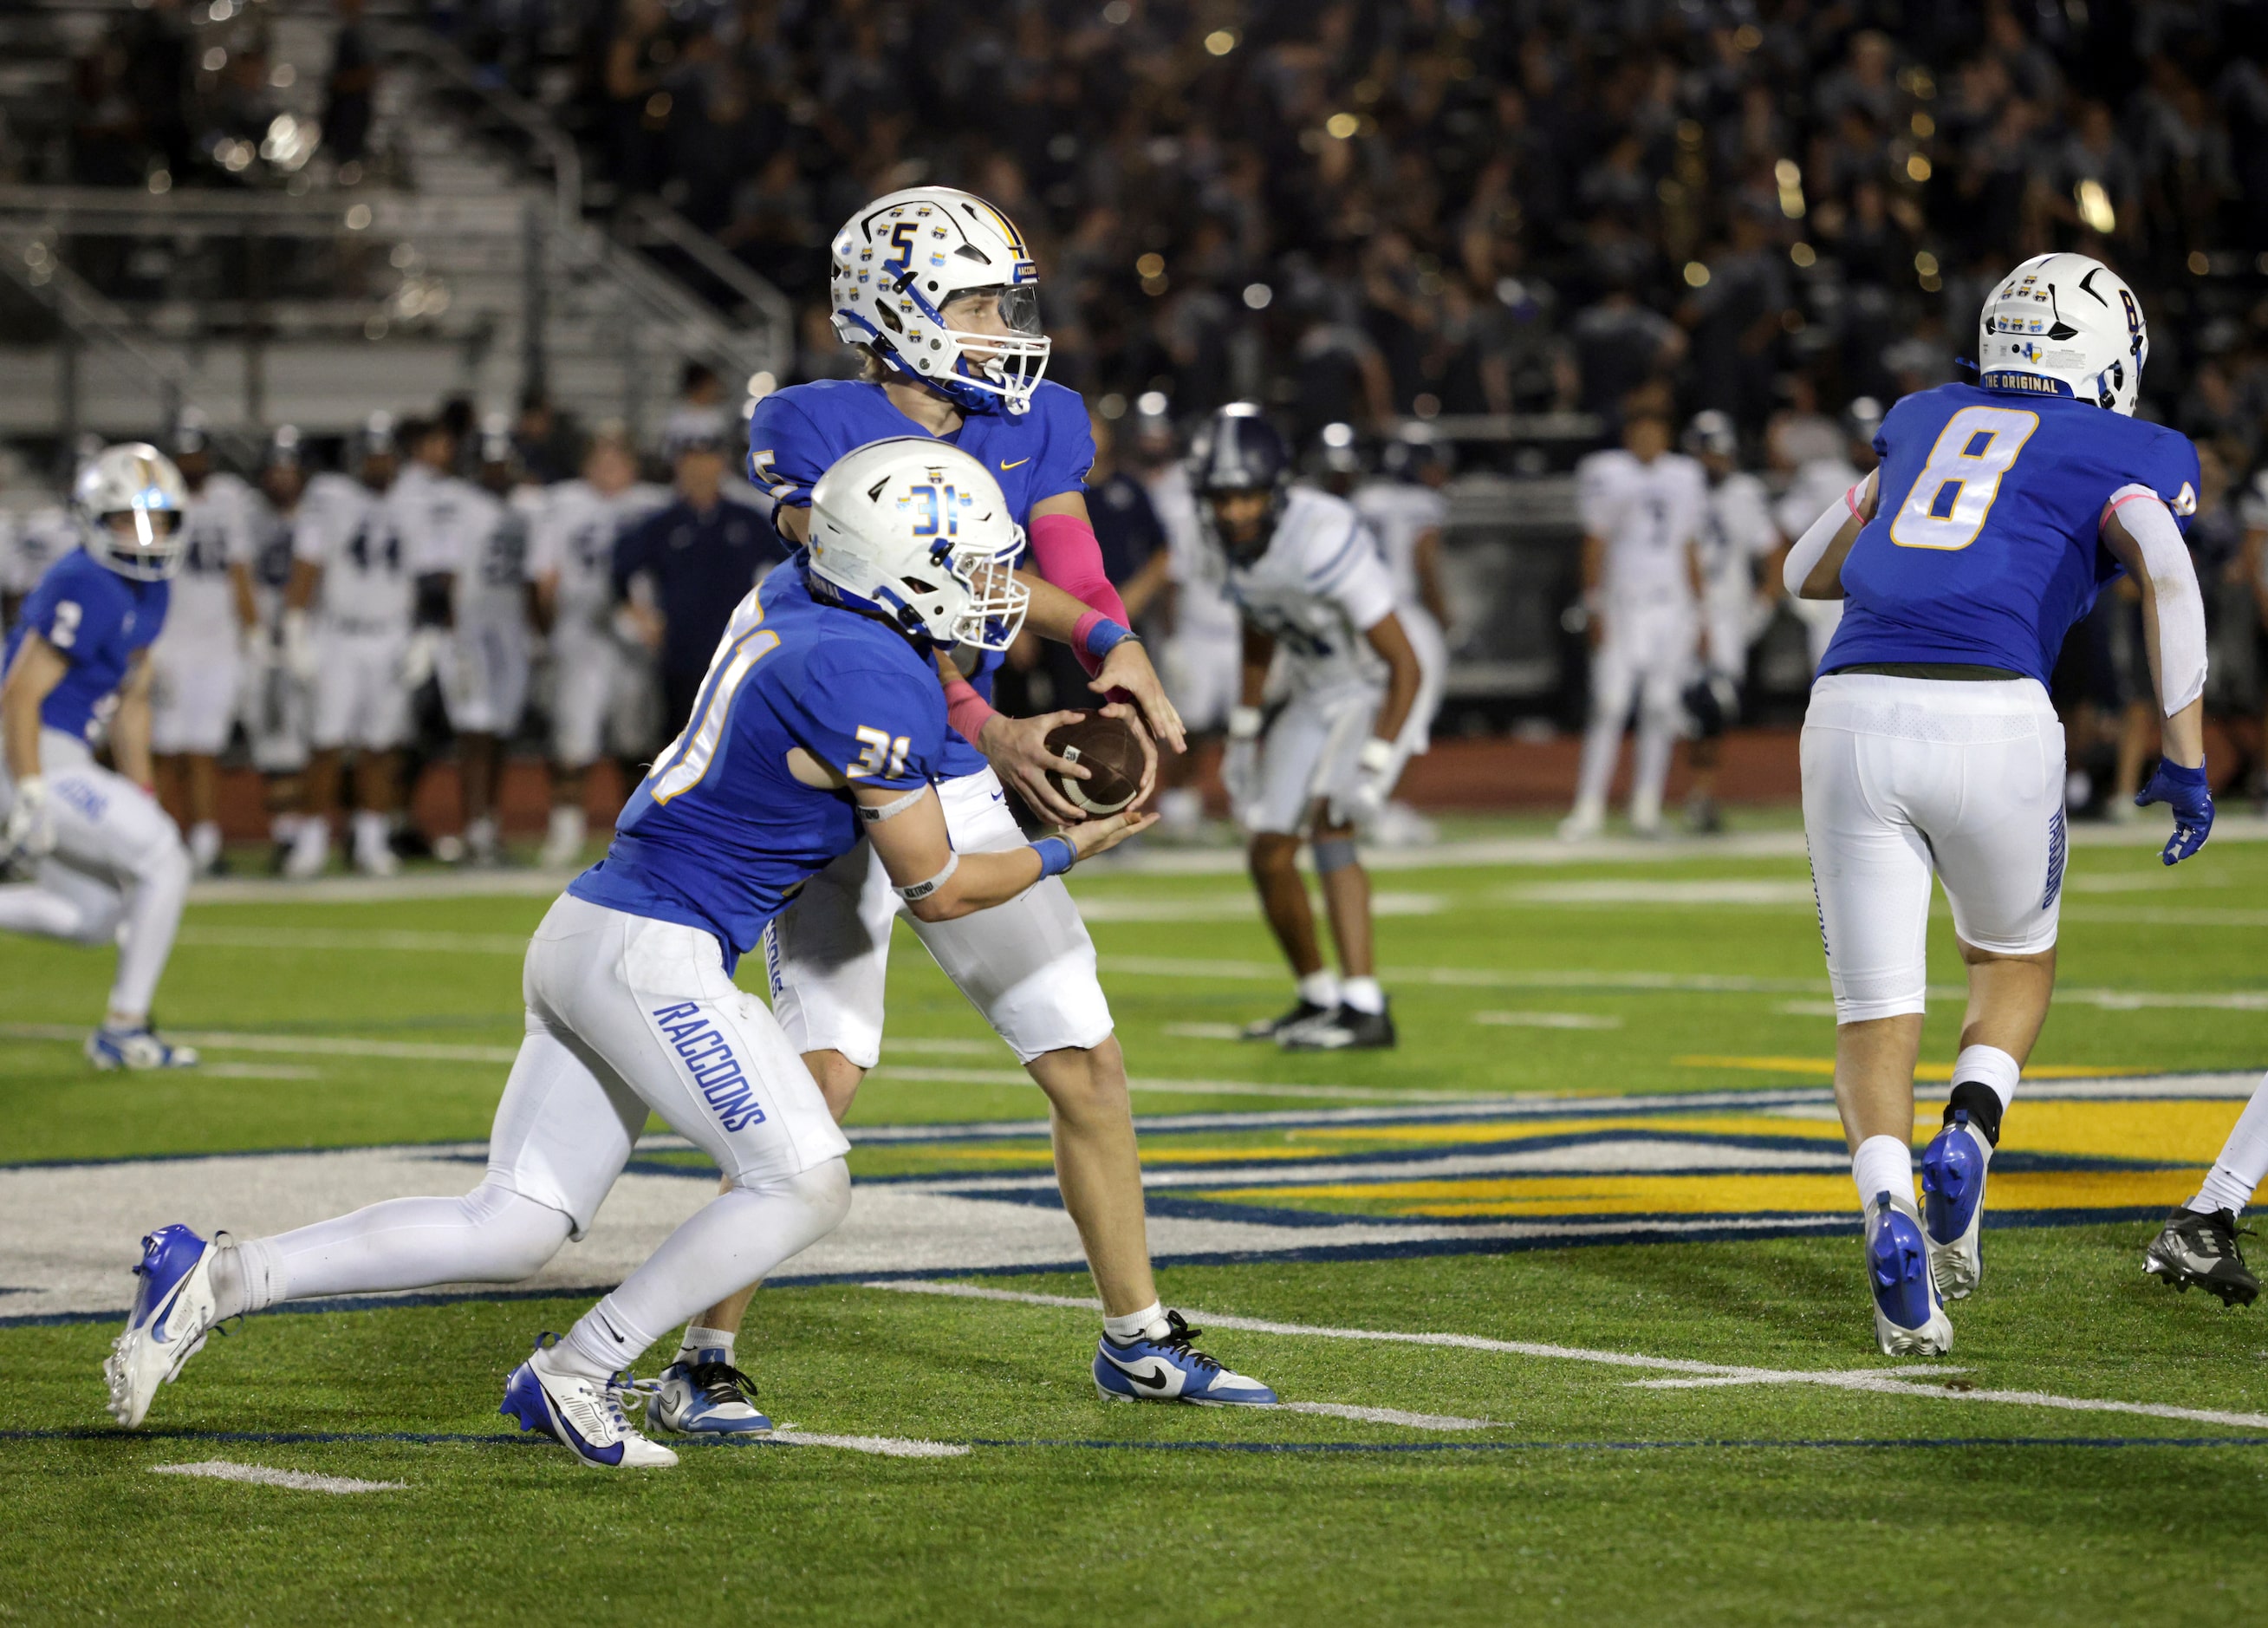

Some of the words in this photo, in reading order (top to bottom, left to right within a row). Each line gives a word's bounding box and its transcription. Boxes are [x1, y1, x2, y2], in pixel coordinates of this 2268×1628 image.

[890, 222, 919, 270] 5
[2118, 289, 2140, 334] 8
[1985, 374, 1998, 388] THE
[2002, 374, 2058, 394] ORIGINAL
[752, 449, 798, 500] 5
[1890, 406, 2039, 550] 8
[910, 485, 958, 537] 31
[50, 599, 82, 648] 2
[847, 724, 911, 779] 31
[653, 1001, 766, 1132] RACCOONS
